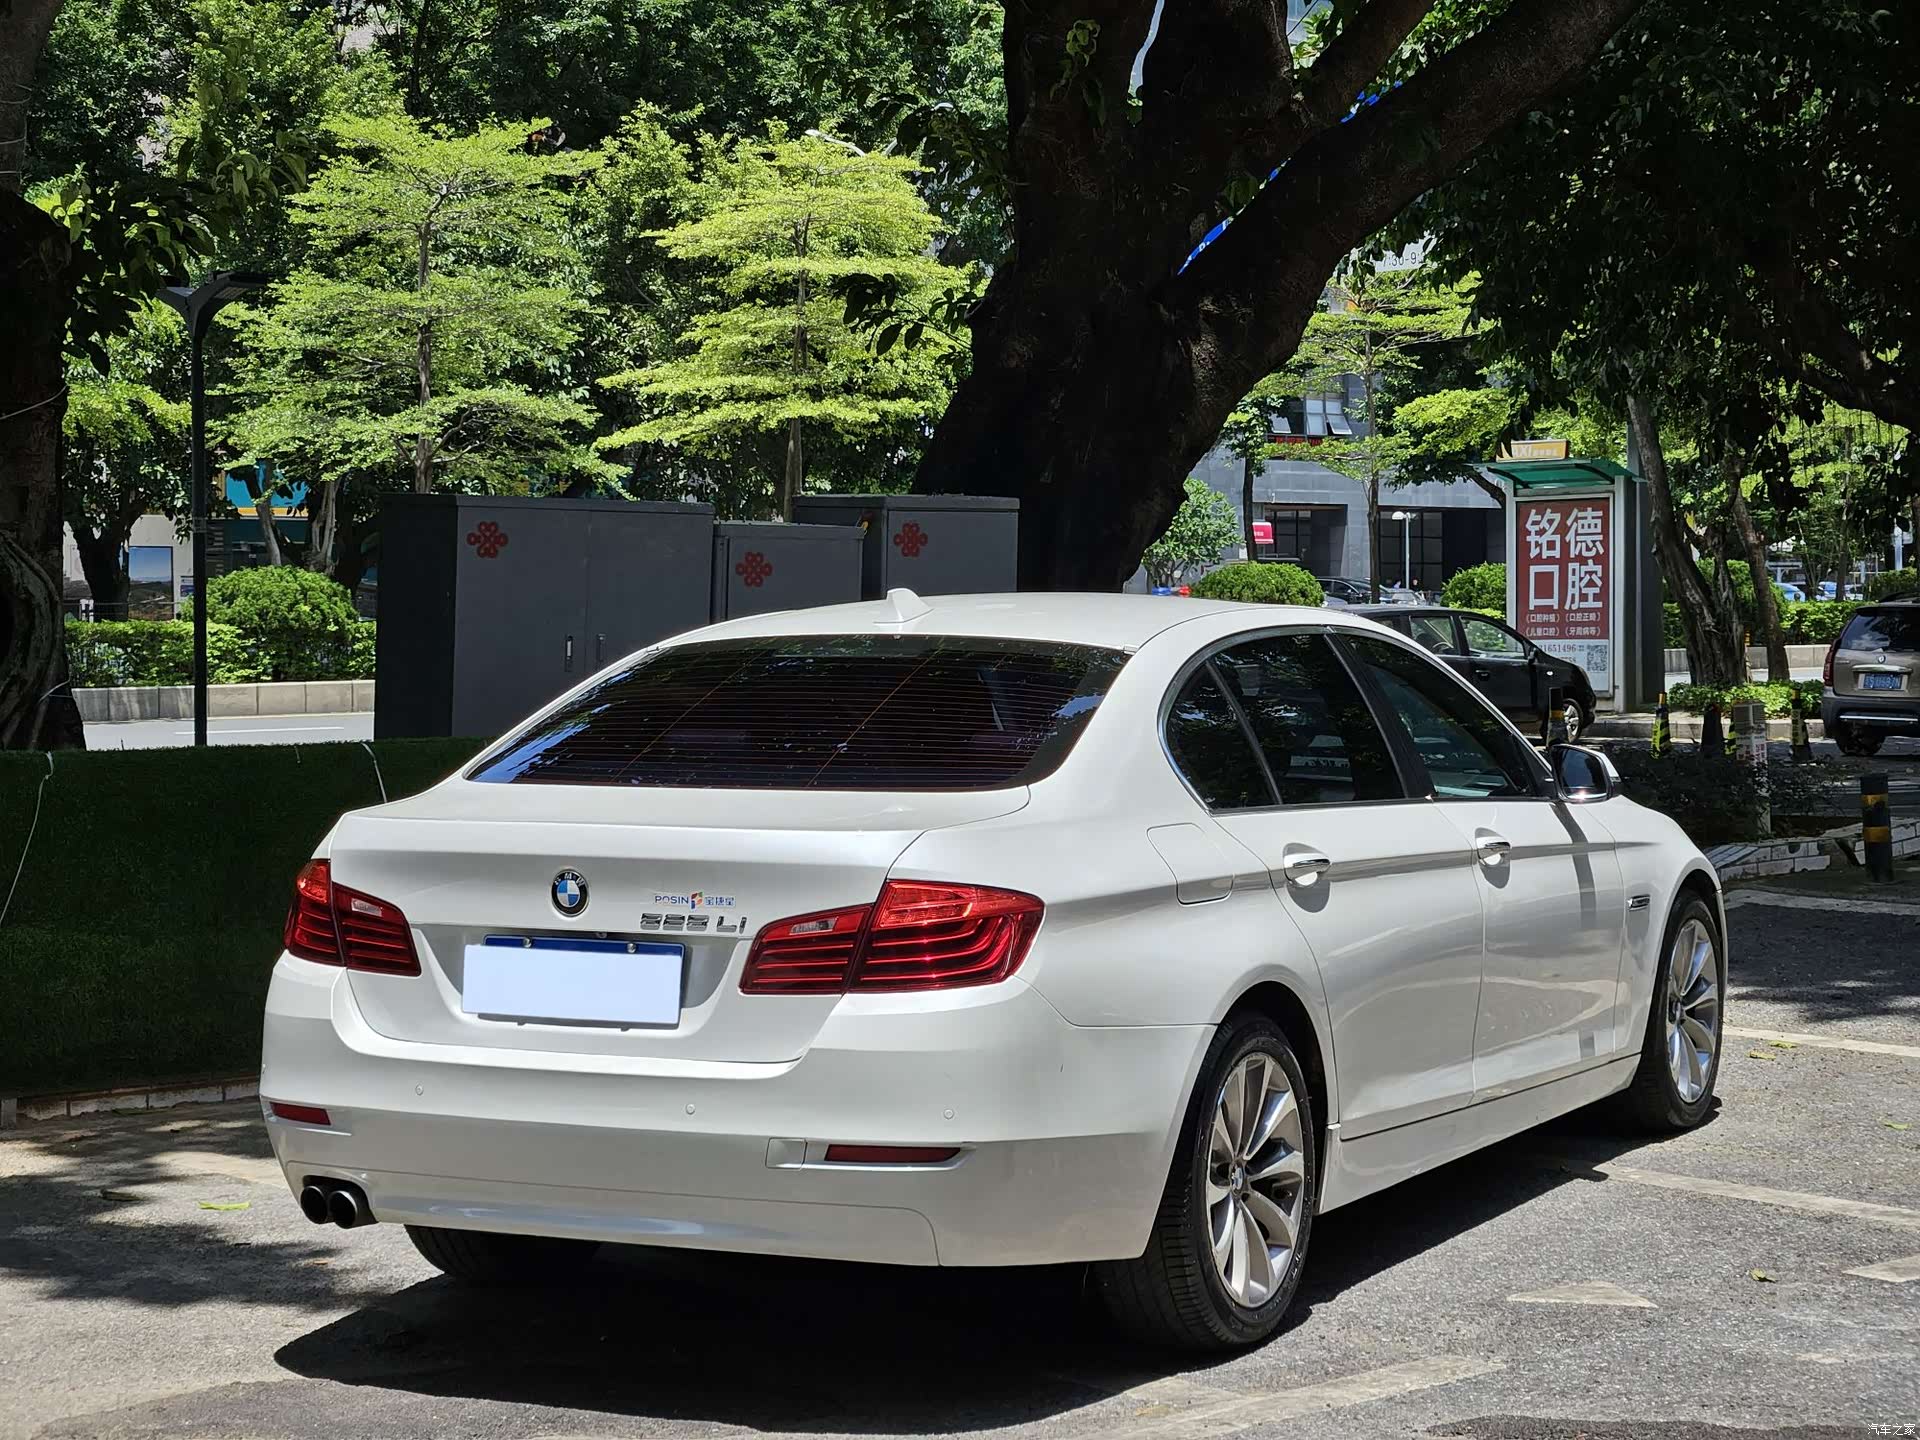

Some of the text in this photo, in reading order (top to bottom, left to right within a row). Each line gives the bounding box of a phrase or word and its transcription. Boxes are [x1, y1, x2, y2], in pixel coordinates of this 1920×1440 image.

[1525, 507, 1604, 560] 铭德
[1528, 560, 1603, 611] 口腔
[655, 895, 689, 904] POSIN
